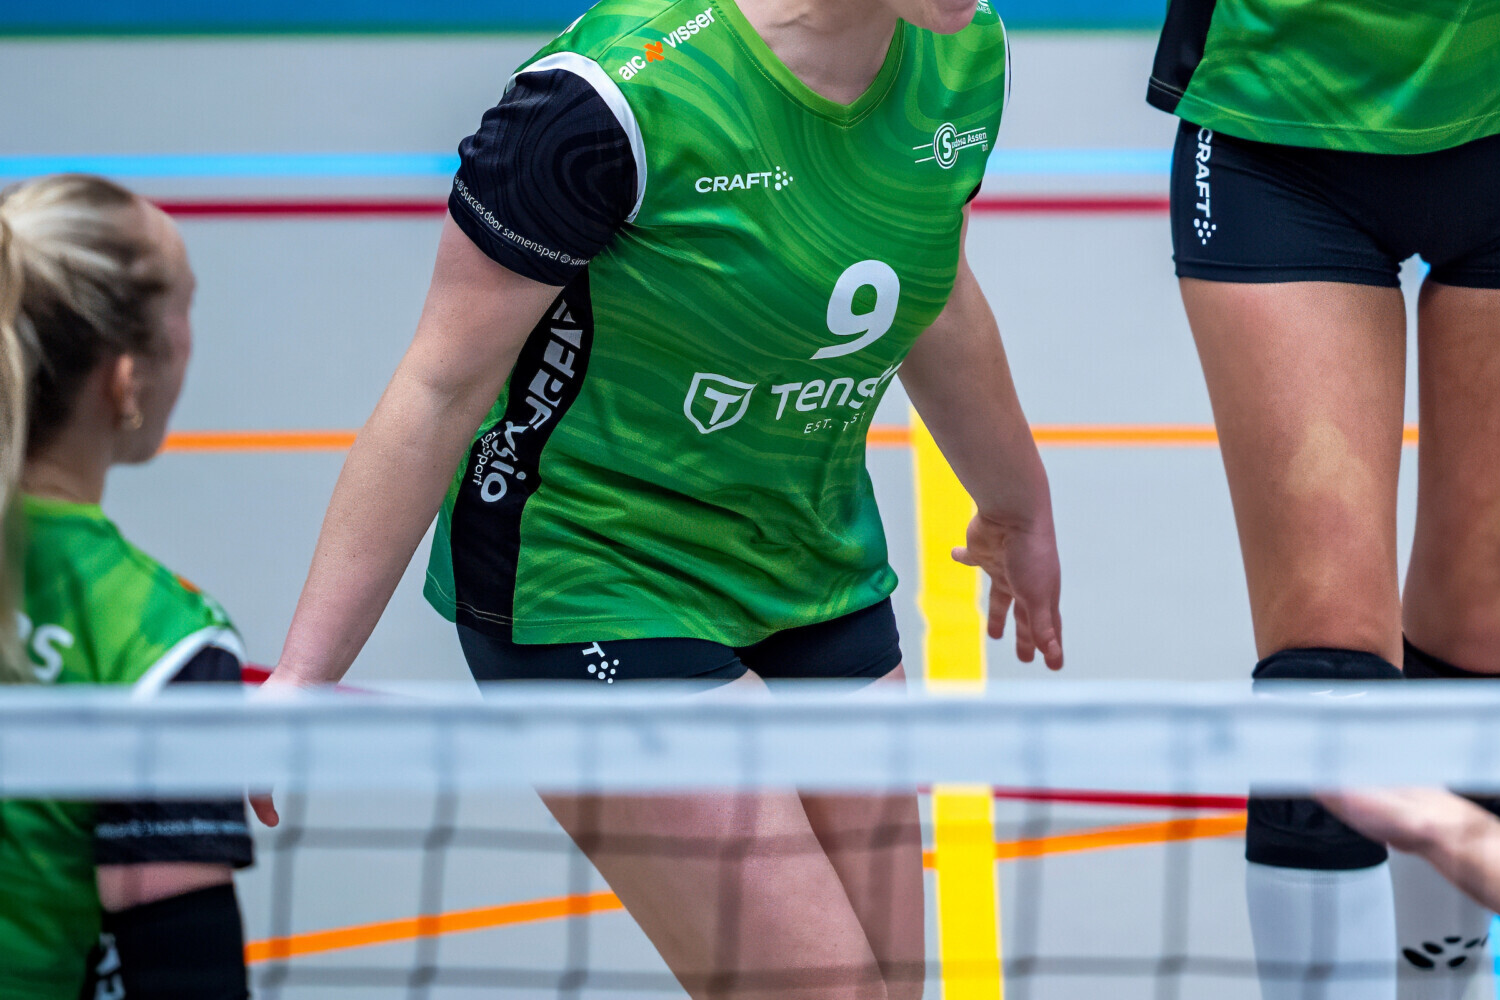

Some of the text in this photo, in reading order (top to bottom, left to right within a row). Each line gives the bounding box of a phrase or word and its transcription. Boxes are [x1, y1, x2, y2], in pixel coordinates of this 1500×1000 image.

[662, 7, 715, 48] visser
[967, 132, 988, 144] Assen
[694, 171, 773, 194] CRAFT
[1195, 127, 1213, 219] CRAFT
[460, 186, 486, 215] Succes
[484, 210, 504, 231] door
[502, 228, 561, 261] samenspel
[809, 259, 901, 360] 9
[803, 418, 833, 434] EST.
